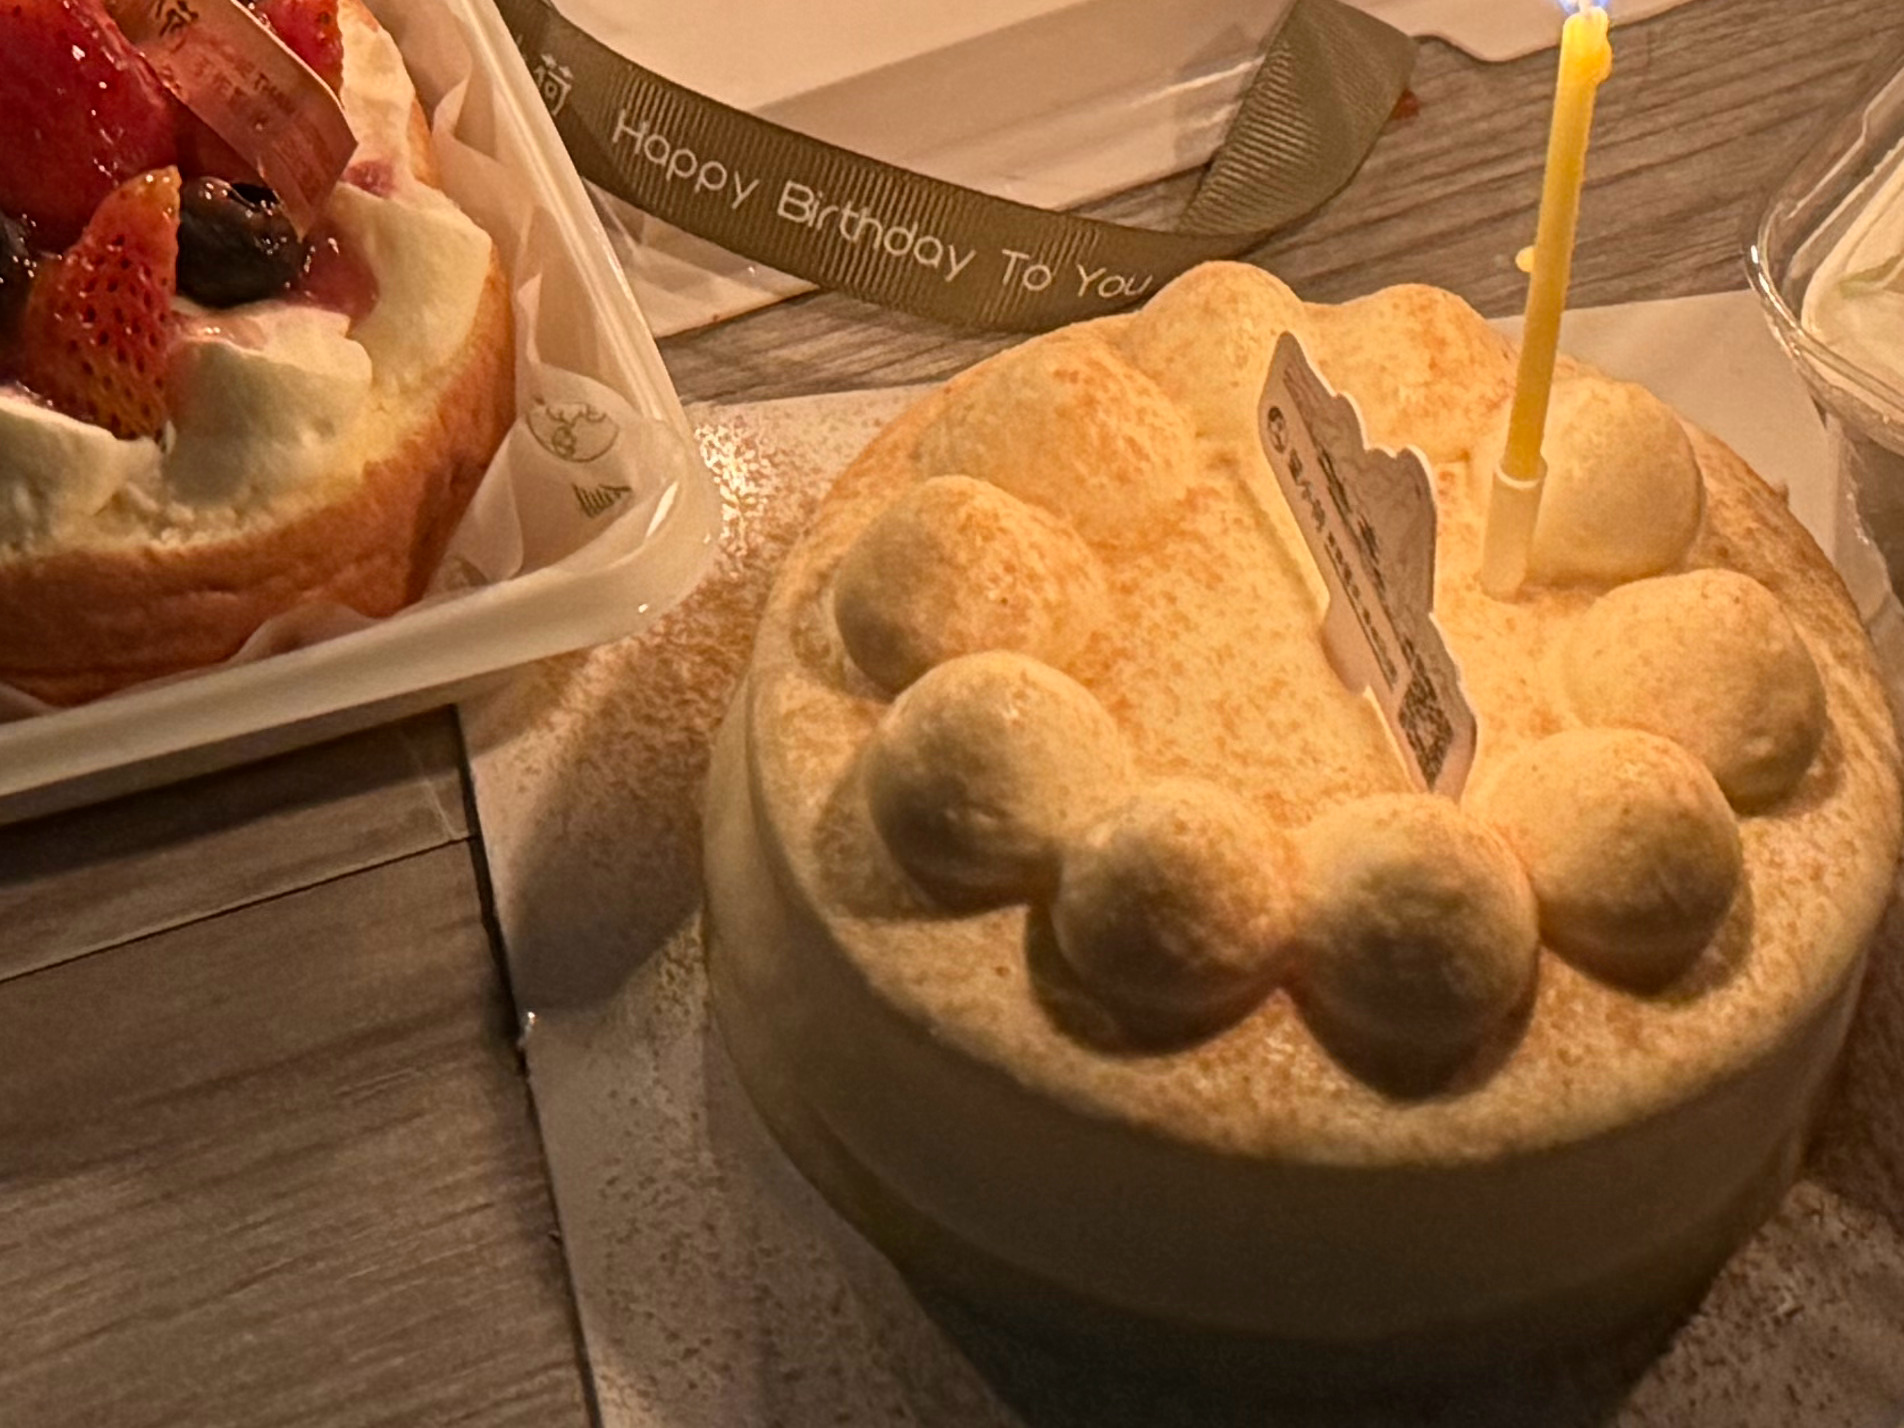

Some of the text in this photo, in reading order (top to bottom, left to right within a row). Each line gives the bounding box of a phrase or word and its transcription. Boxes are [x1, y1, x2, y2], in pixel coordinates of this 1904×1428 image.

[612, 107, 762, 210] Happy
[777, 179, 976, 282] Birthday
[1001, 249, 1053, 293] To
[1076, 261, 1153, 301] You
